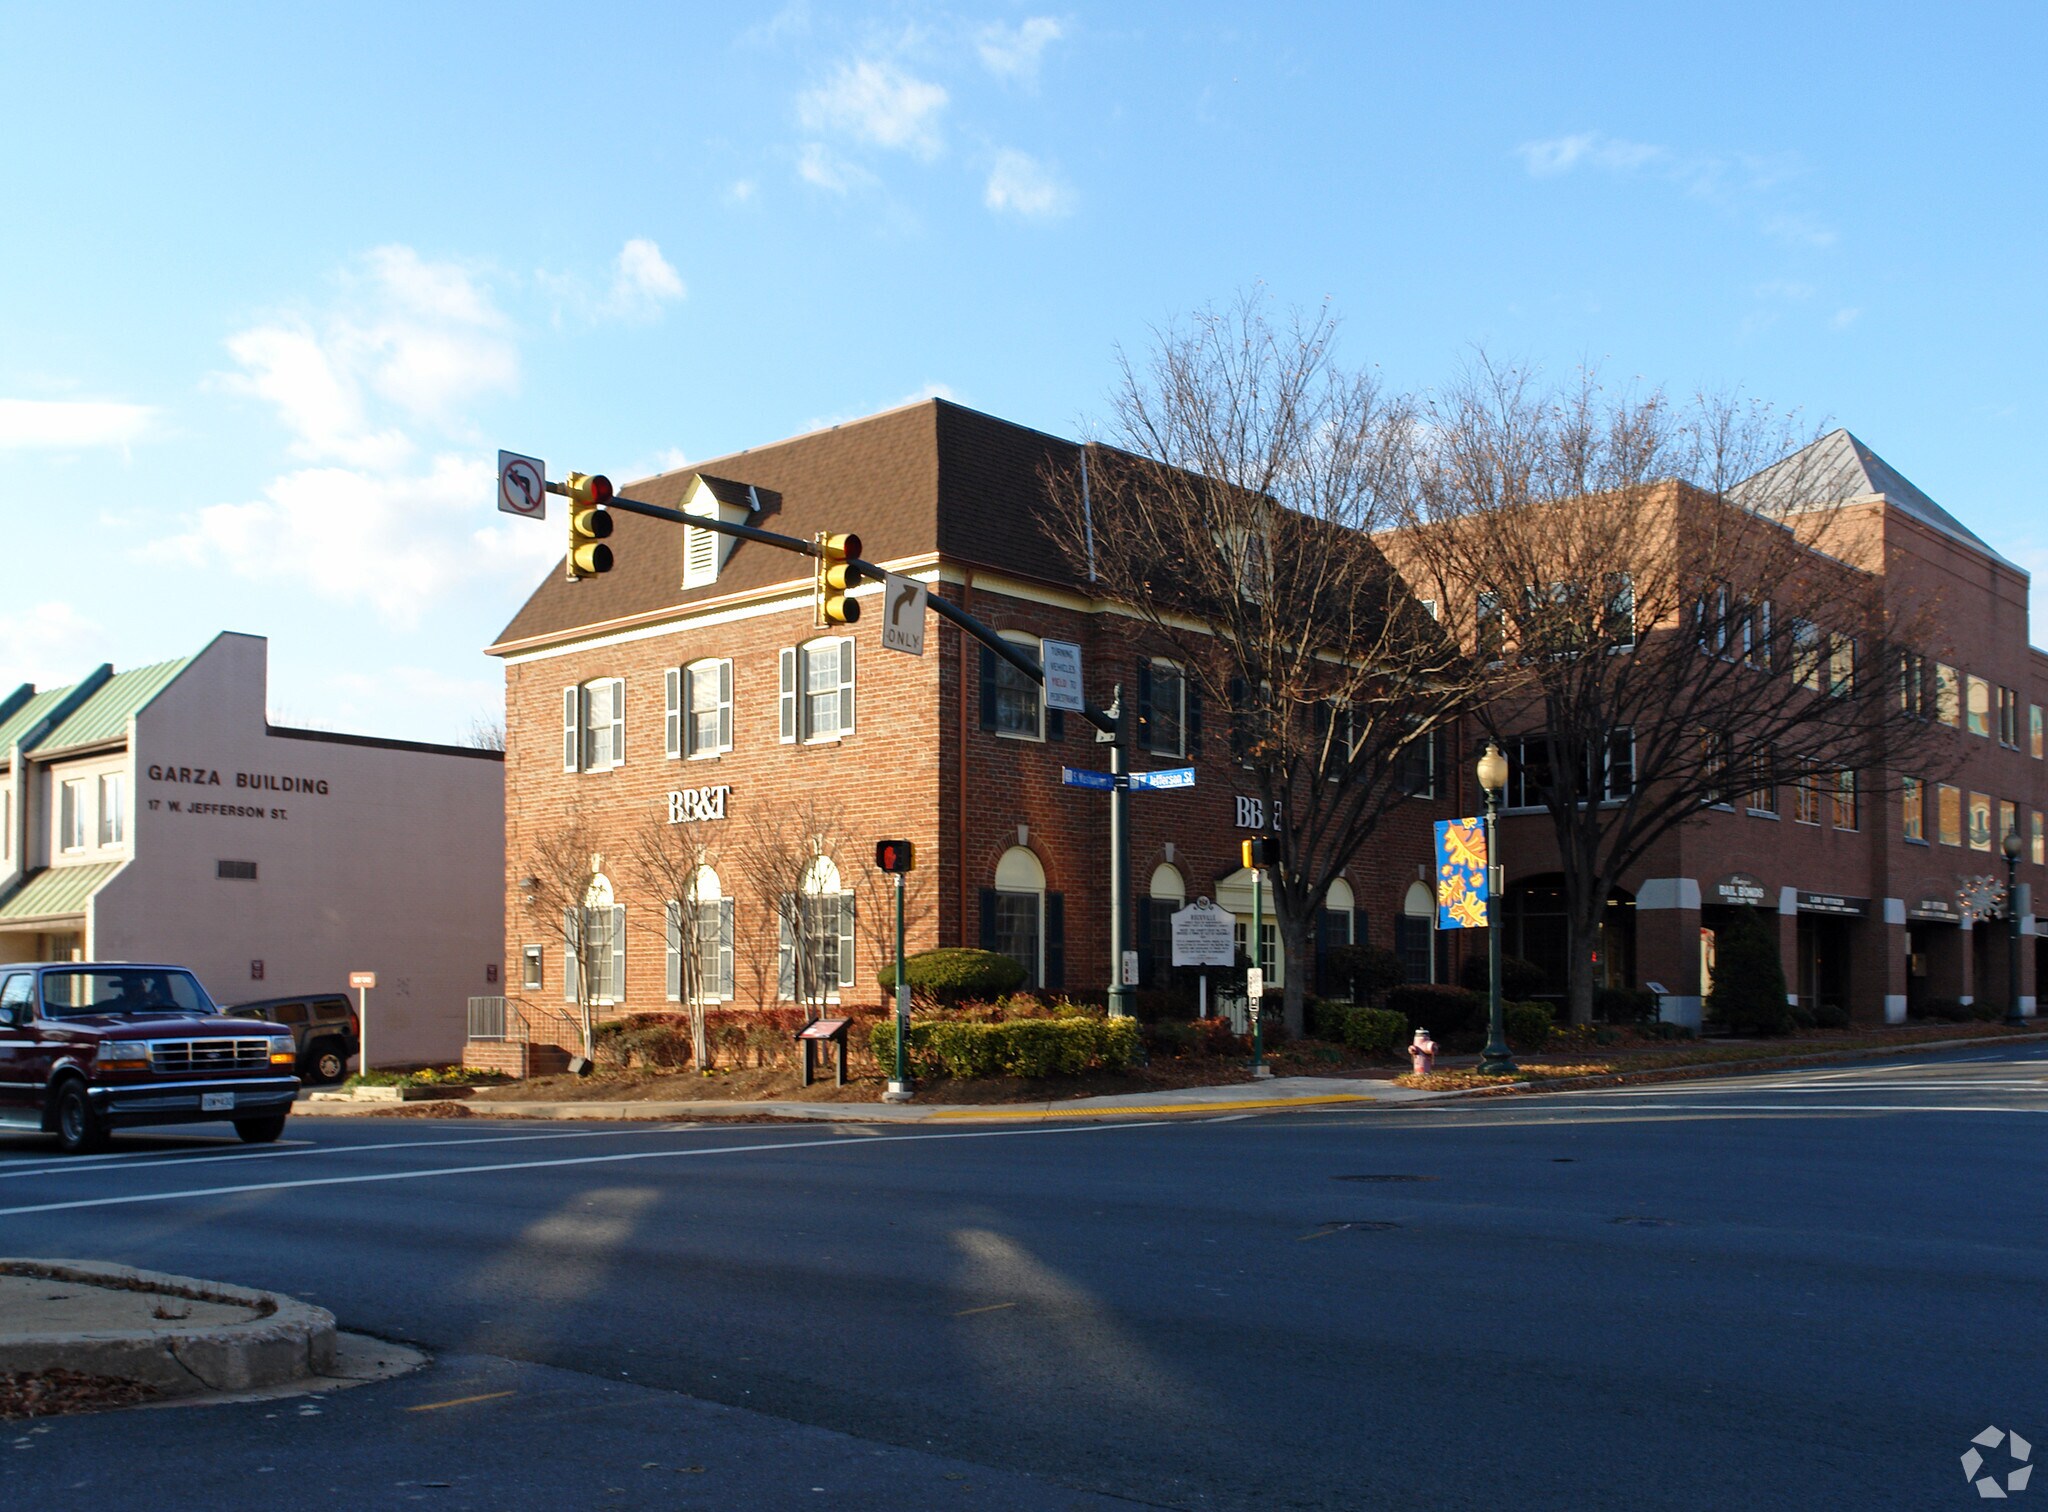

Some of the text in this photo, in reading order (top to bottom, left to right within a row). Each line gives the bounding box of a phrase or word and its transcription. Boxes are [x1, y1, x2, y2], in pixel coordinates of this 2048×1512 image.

[888, 628, 920, 648] ONLY
[1051, 646, 1074, 659] TURNING
[1050, 662, 1076, 674] VEHICLES
[1051, 677, 1077, 689] YIELD TO
[148, 765, 329, 795] GARZA BUILDING
[1149, 774, 1181, 786] Jefferson
[1183, 771, 1193, 783] St
[148, 800, 288, 820] 17 W. JEFFERSON ST.
[667, 785, 731, 824] BB&T
[1718, 884, 1765, 899] BAIL BONDS
